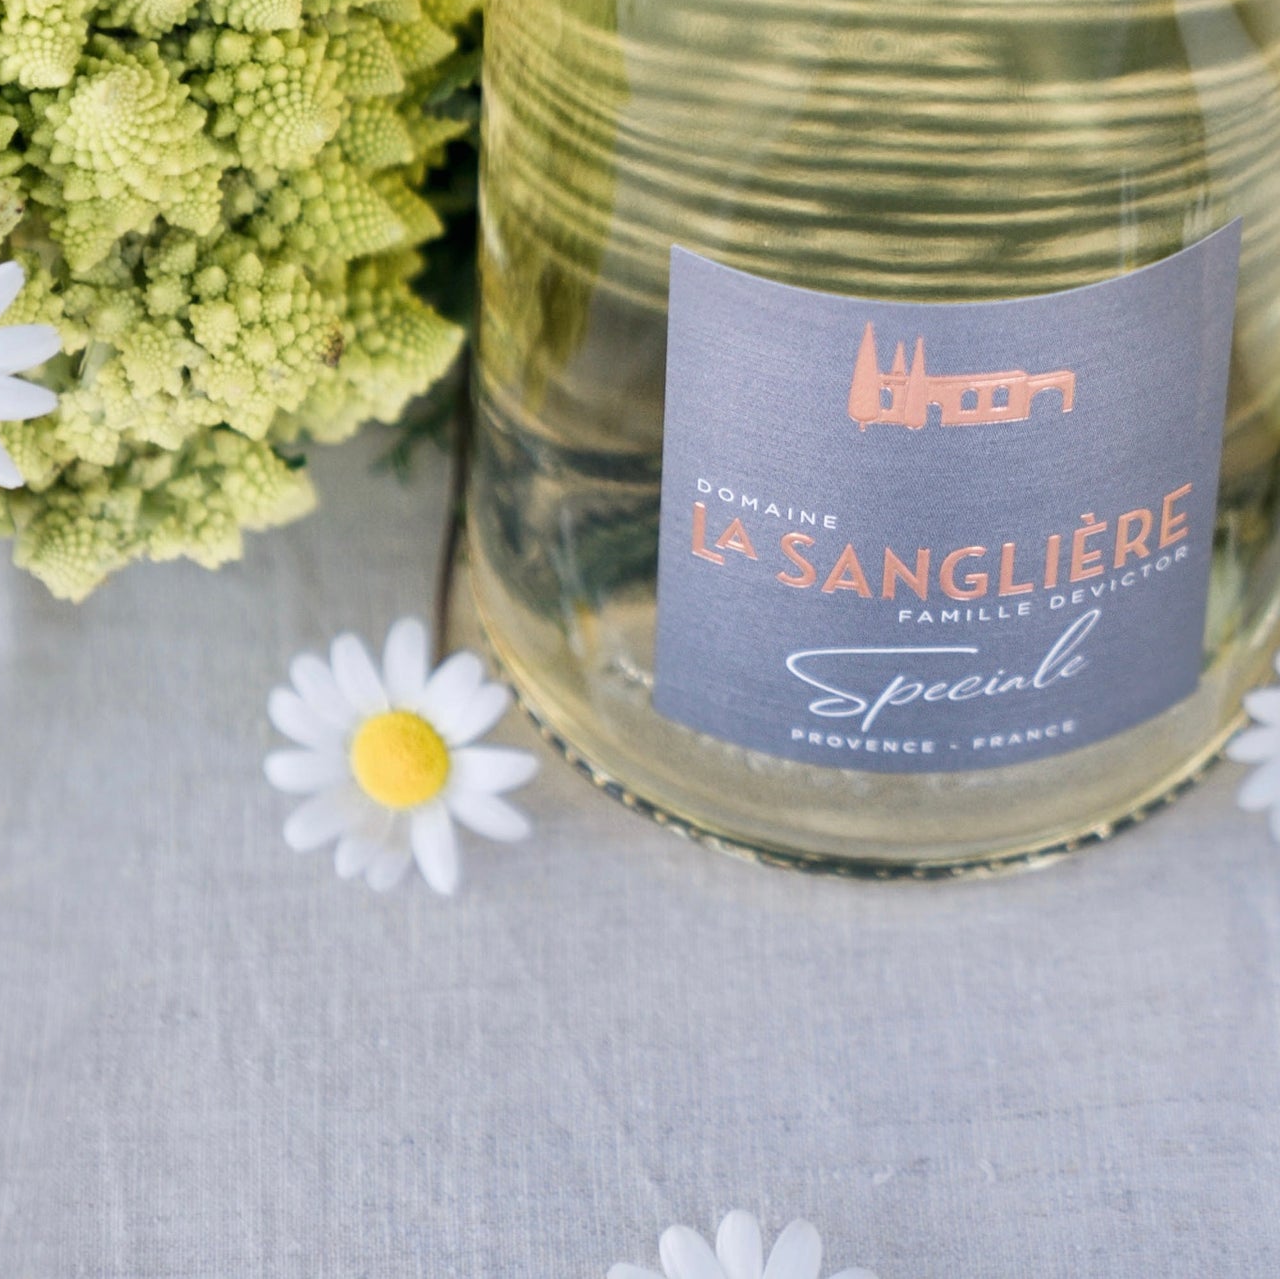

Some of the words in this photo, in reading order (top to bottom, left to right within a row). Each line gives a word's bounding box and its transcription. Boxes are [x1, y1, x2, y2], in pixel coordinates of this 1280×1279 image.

[696, 478, 838, 529] DOMAINE
[691, 501, 759, 566] LA
[775, 482, 1194, 602] SANGLIÈRE
[898, 601, 1032, 623] FAMILLE
[1049, 545, 1189, 611] DEVICTOR
[791, 728, 935, 754] PROVENCE
[972, 720, 1076, 749] FRANCE
